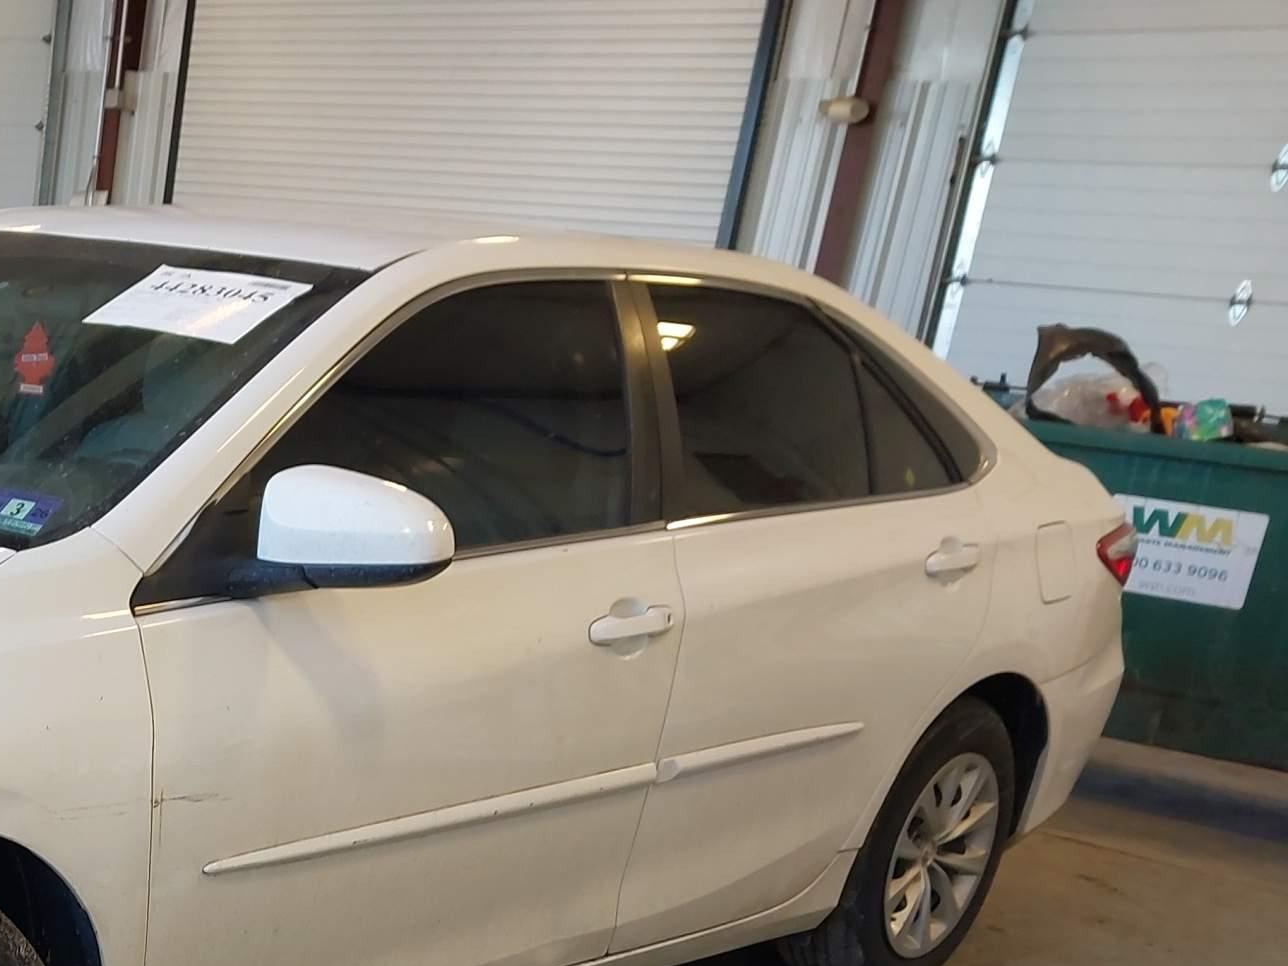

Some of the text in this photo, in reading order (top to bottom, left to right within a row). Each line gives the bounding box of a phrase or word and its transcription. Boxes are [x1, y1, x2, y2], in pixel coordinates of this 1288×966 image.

[151, 280, 275, 303] 44283045
[10, 502, 25, 516] 3
[1132, 505, 1234, 547] WM
[1152, 559, 1183, 575] 633
[1187, 563, 1229, 583] 9096
